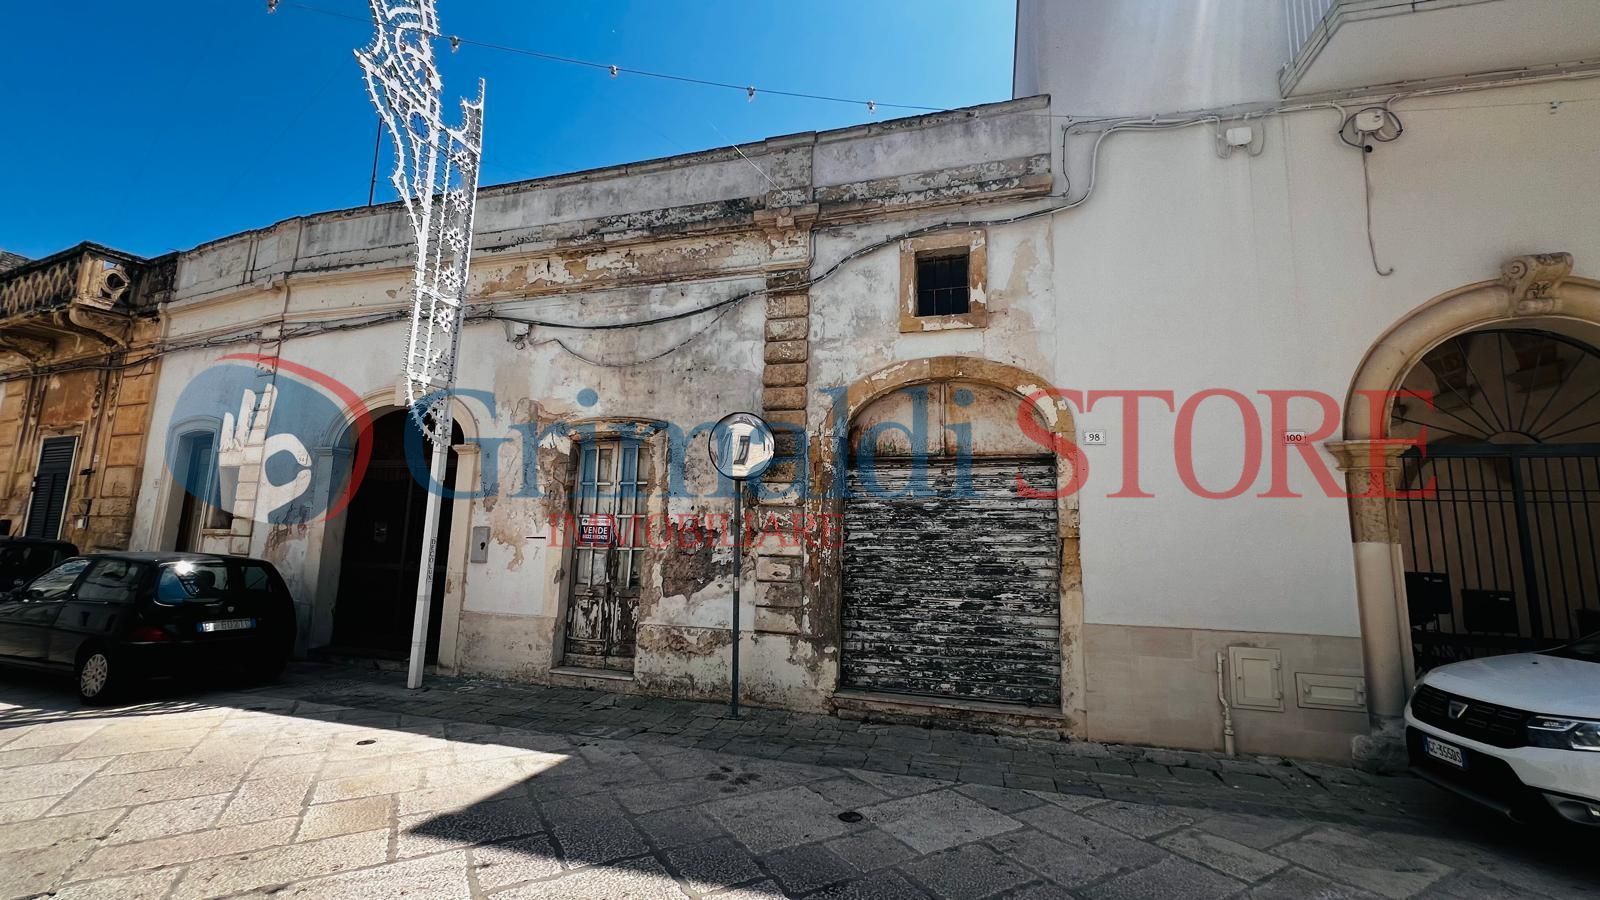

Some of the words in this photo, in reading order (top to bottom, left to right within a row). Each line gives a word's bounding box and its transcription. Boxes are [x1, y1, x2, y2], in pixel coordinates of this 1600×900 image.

[1089, 433, 1101, 442] 98
[1286, 434, 1302, 442] 100
[583, 526, 608, 535] VENDE
